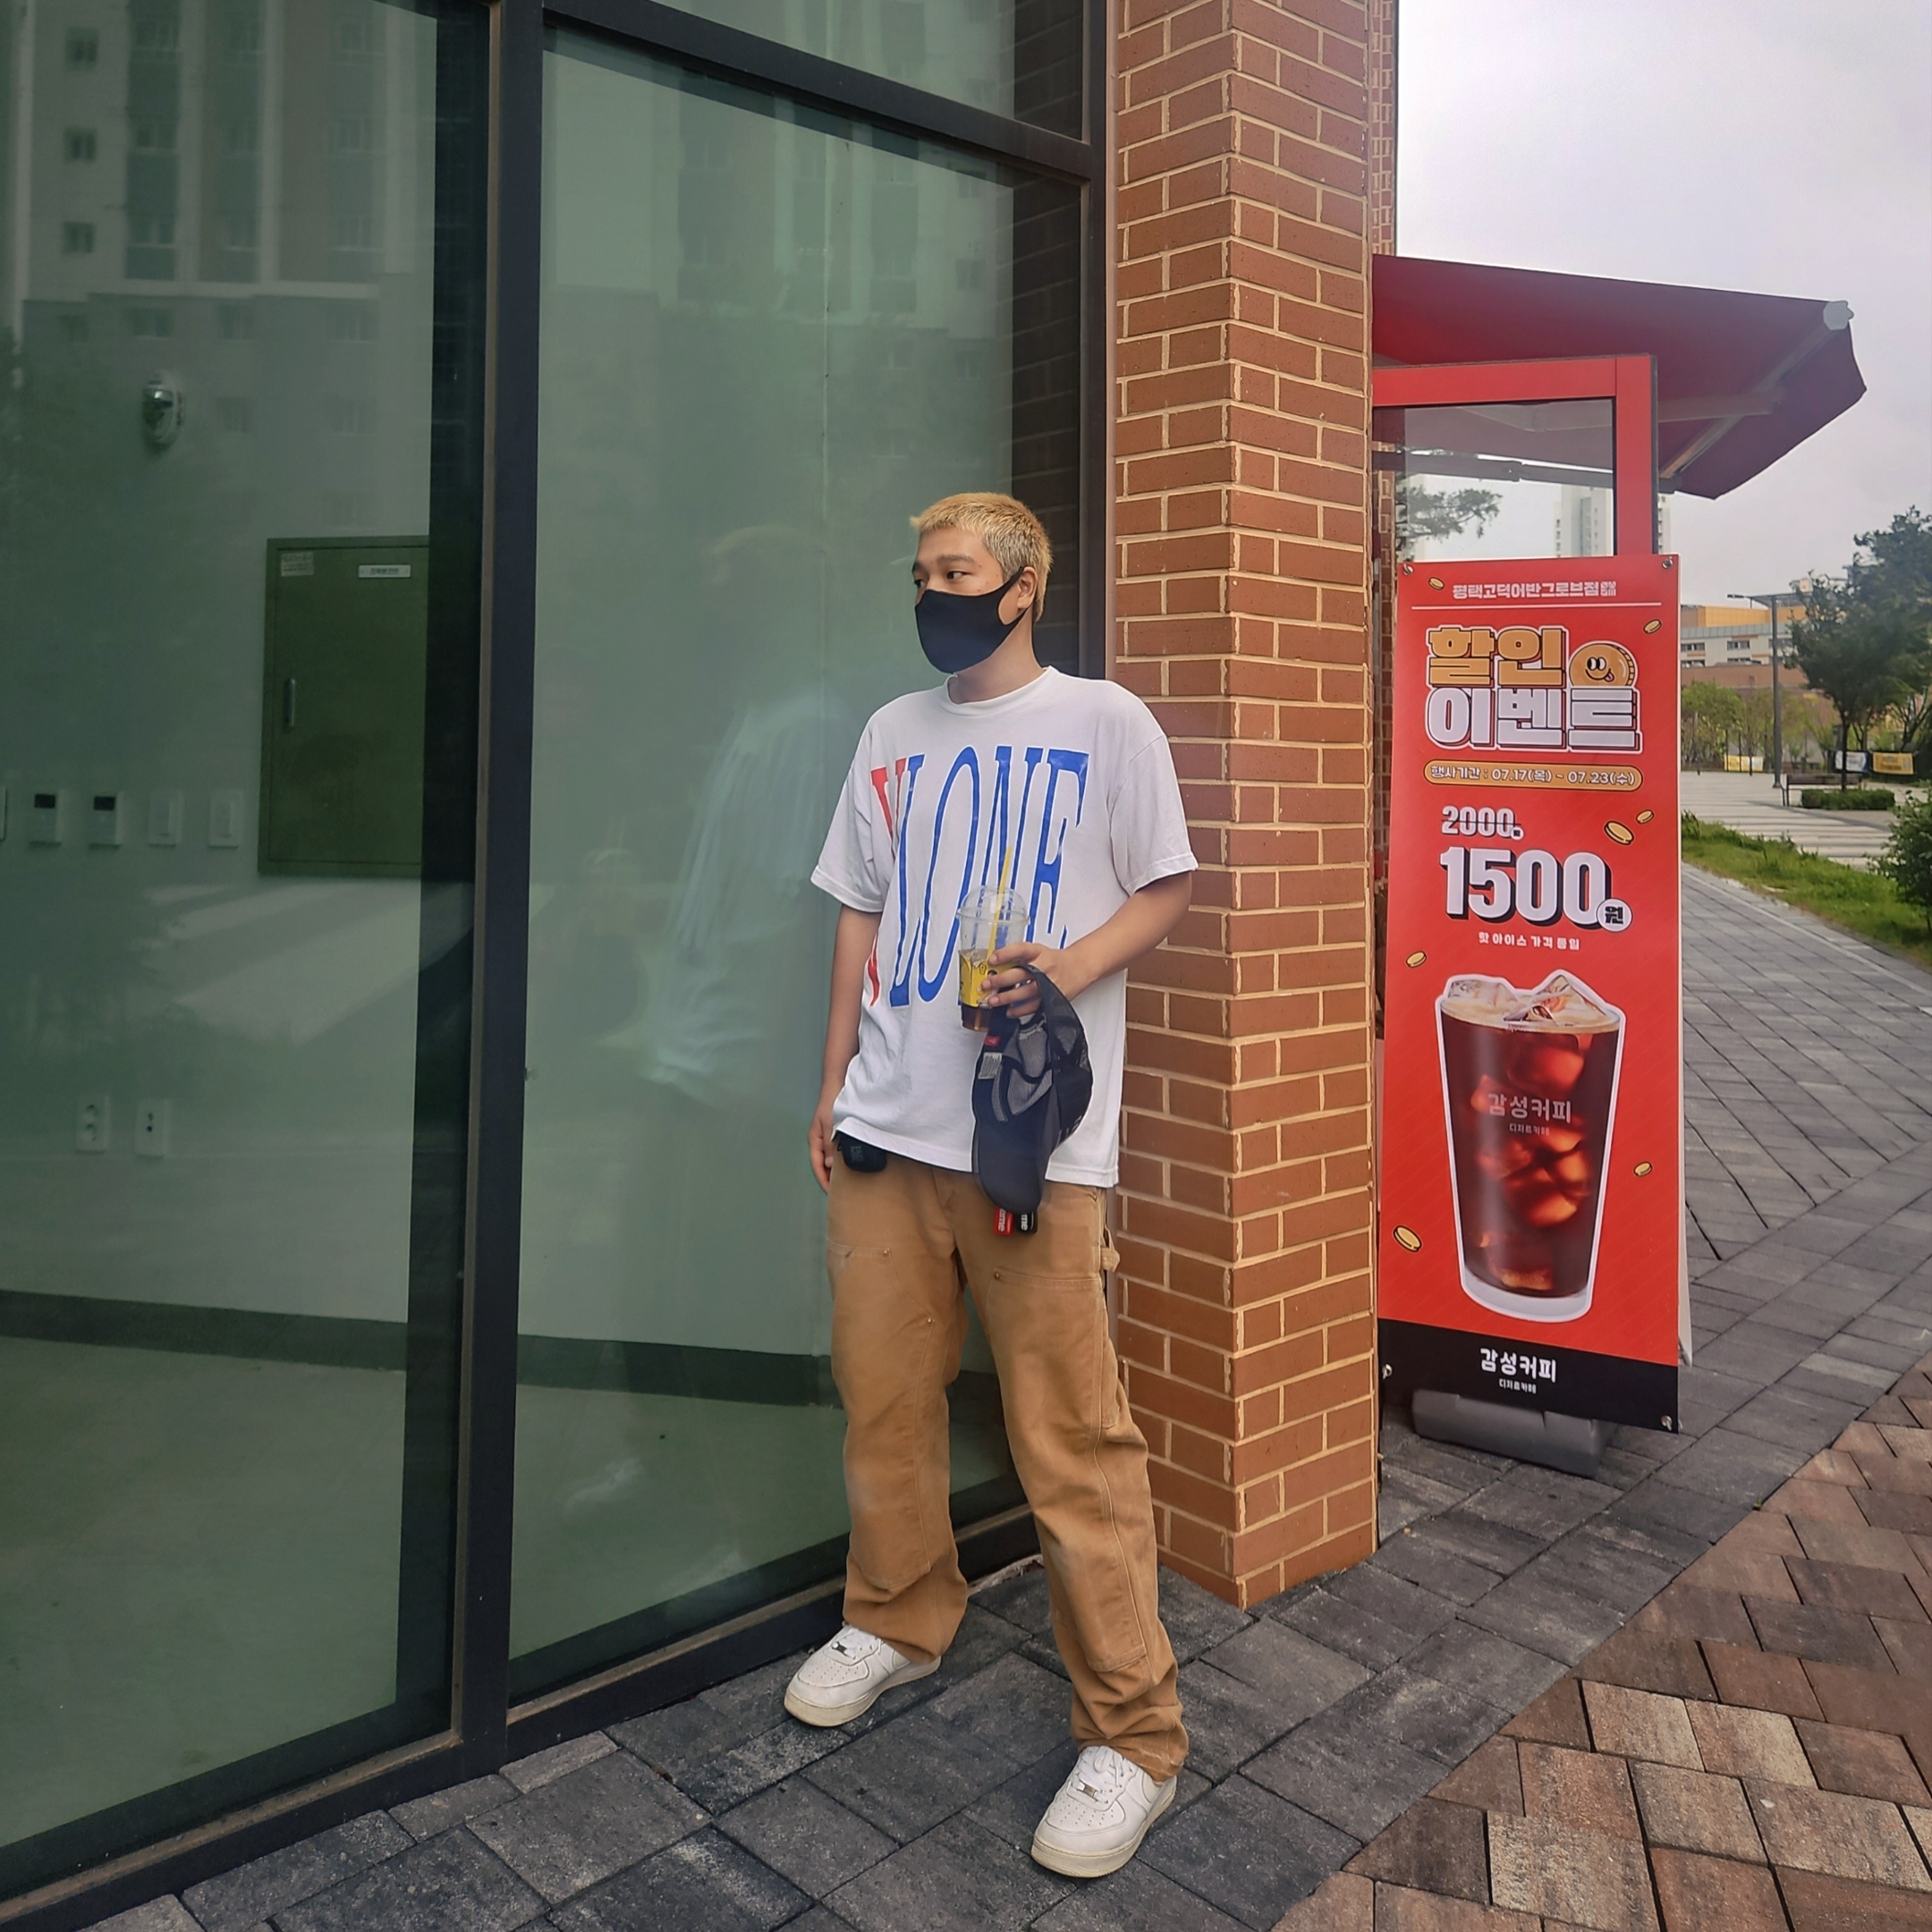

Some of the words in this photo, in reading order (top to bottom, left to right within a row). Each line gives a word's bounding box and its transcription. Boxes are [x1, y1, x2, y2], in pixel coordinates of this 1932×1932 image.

[1428, 627, 1567, 687] 할인
[1427, 686, 1641, 753] 이벤트
[1431, 766, 1480, 780] 행사기간
[1491, 768, 1553, 783] 07.17(목)
[1567, 771, 1635, 785] 07.23(수)
[1492, 932, 1527, 946] 아이스
[1487, 1093, 1572, 1124] 감성커피
[1479, 1347, 1556, 1383] 감성커피
